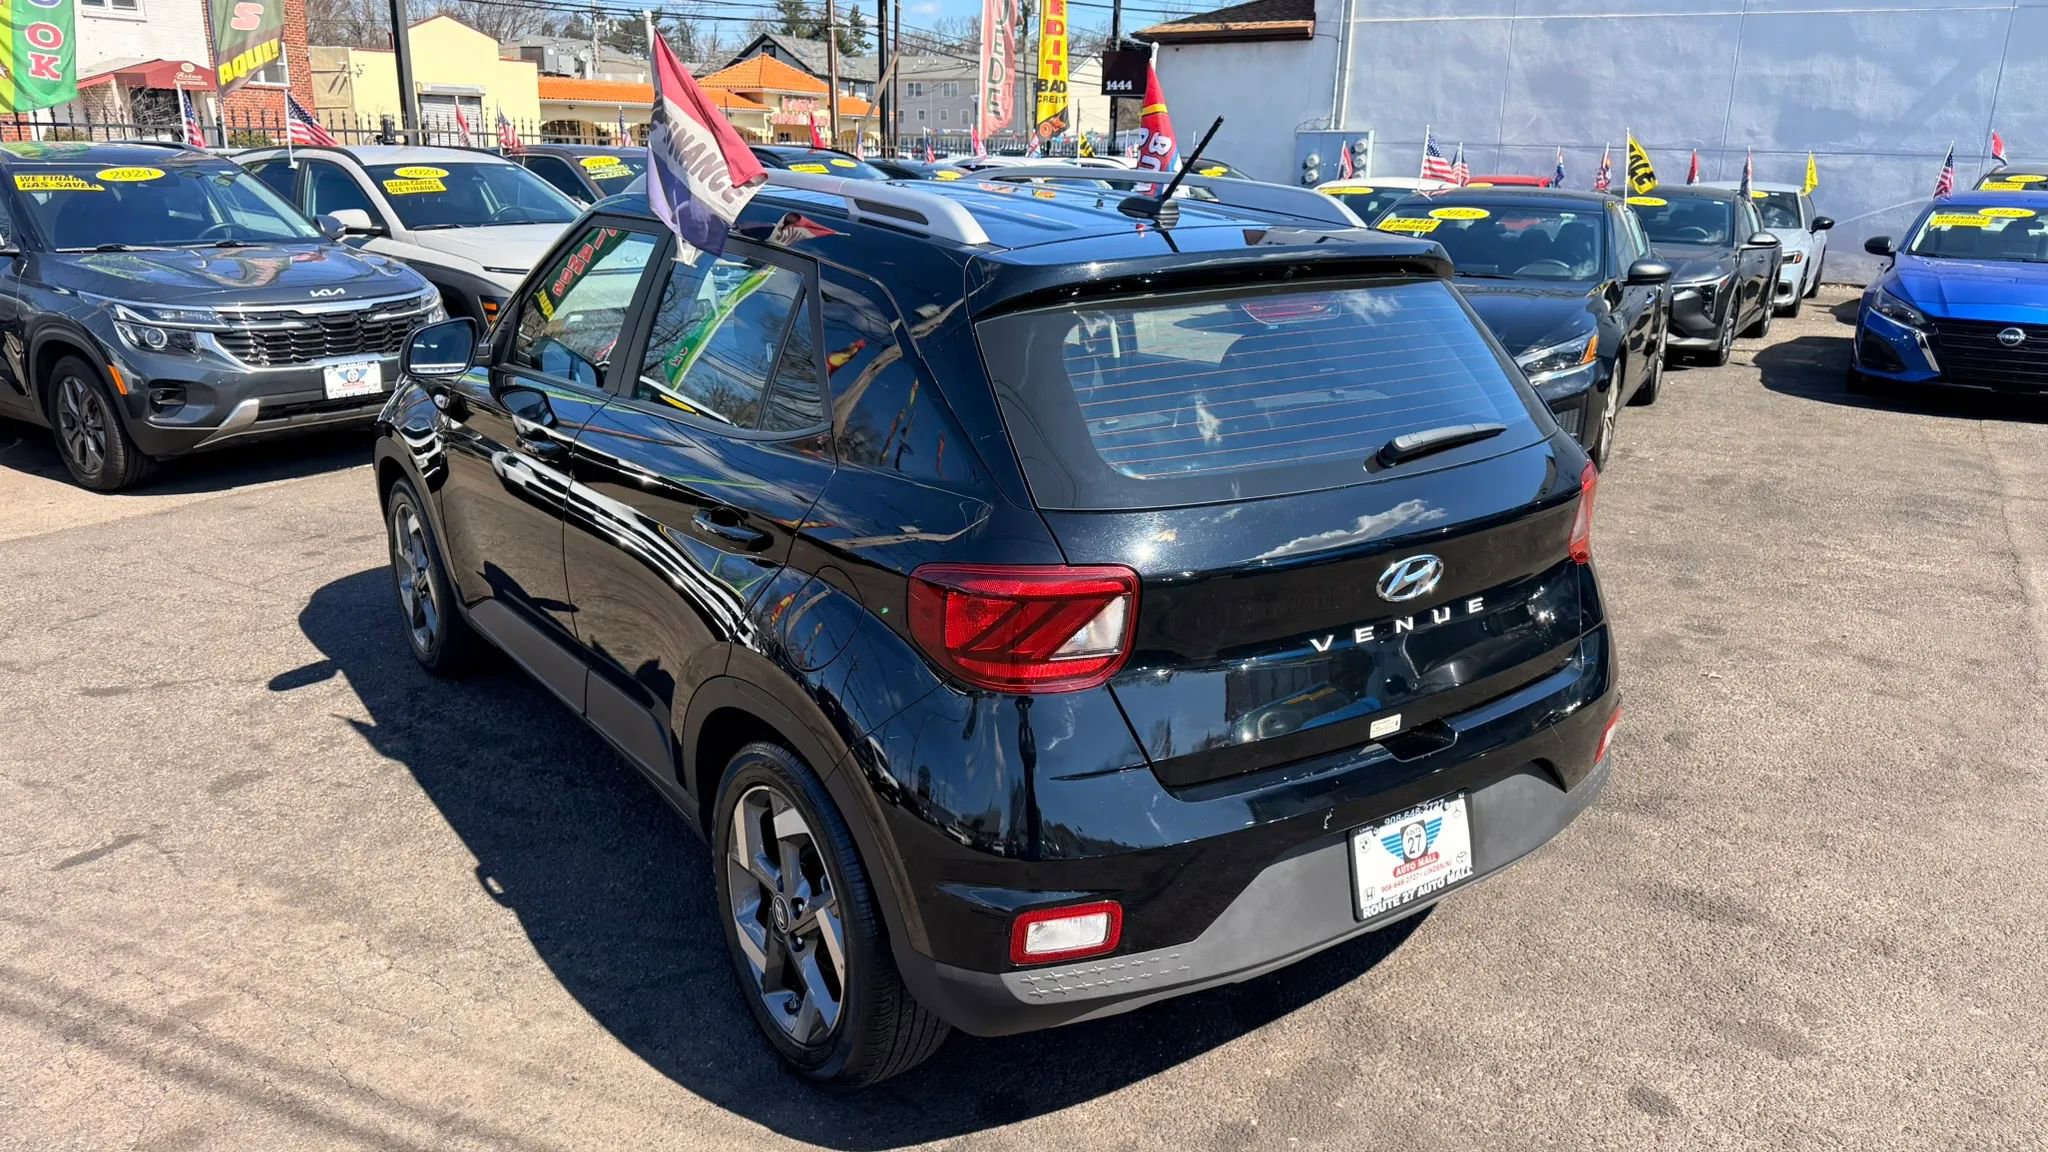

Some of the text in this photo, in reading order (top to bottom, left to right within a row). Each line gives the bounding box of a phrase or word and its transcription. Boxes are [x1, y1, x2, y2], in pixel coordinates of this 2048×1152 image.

[218, 37, 280, 86] AQUI!
[1038, 79, 1067, 93] BAD
[1105, 80, 1132, 91] 1444
[1309, 597, 1484, 652] VENUE
[1407, 834, 1422, 856] 27
[1395, 853, 1437, 877] AUTO MALL
[1361, 866, 1474, 919] ROUTE 27 AUTO MALL
